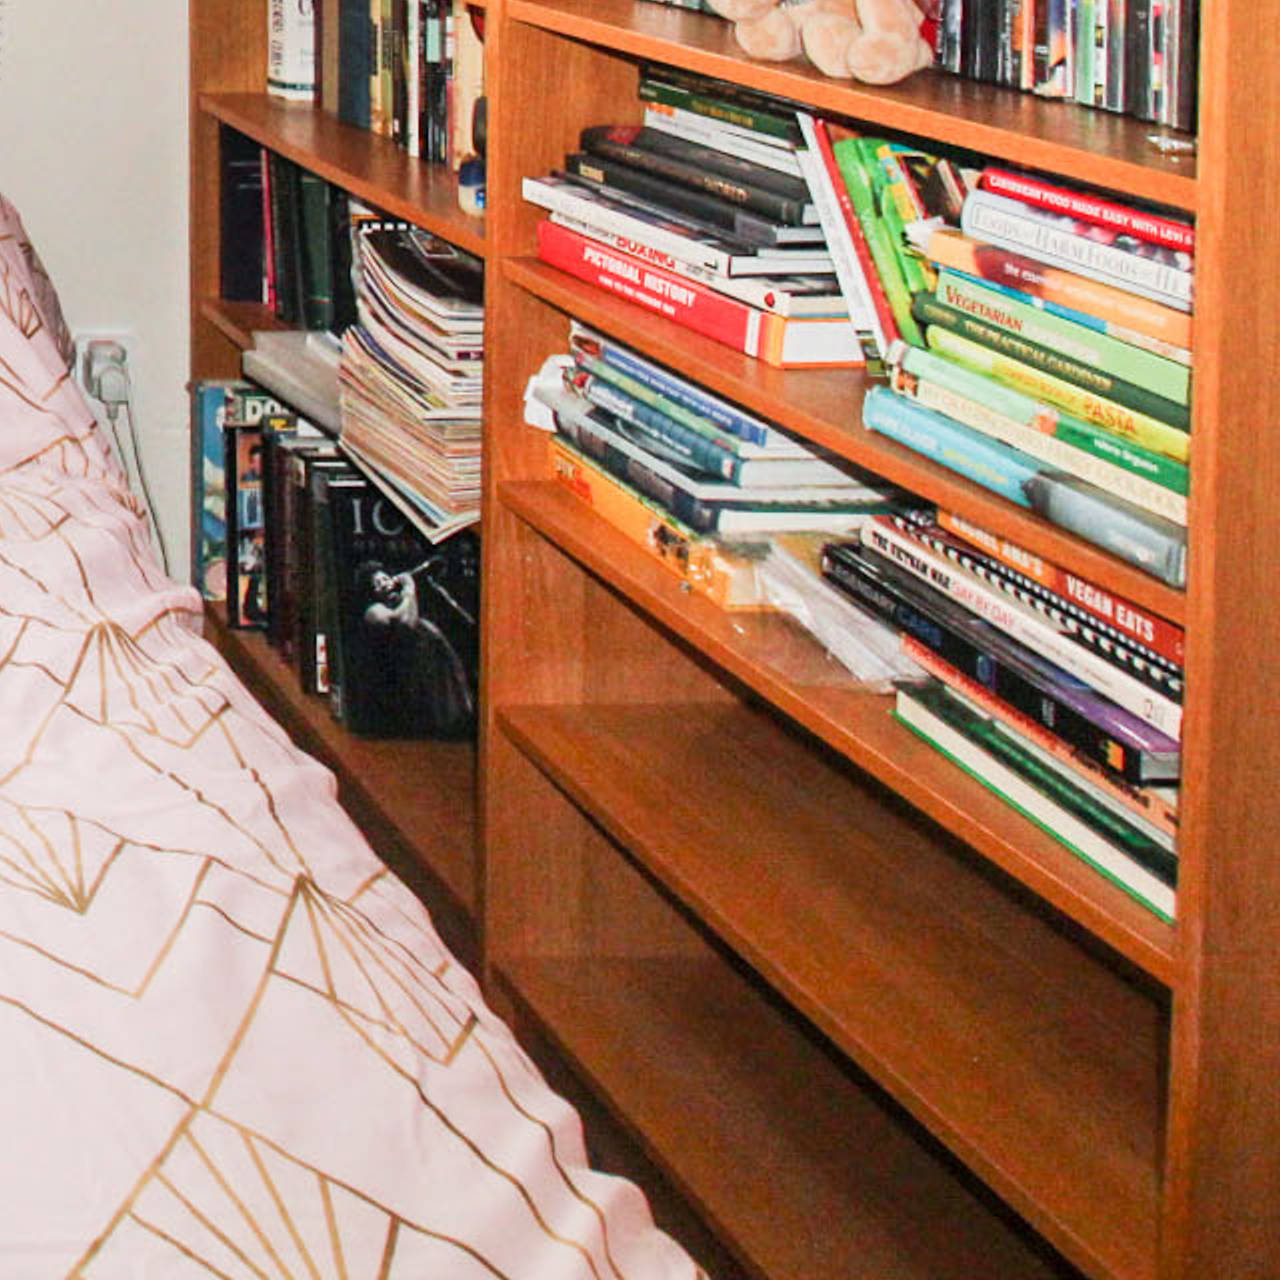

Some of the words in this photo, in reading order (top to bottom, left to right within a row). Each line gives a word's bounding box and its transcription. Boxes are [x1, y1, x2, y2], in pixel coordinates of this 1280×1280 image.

[1042, 192, 1070, 208] FOOD
[1072, 199, 1101, 217] MADE
[1103, 208, 1129, 226] EASY
[1131, 216, 1158, 236] WITH
[583, 245, 641, 284] PICTORIAL
[644, 271, 697, 308] HISTORY
[945, 285, 1024, 332] VEGETARIAN
[1066, 573, 1113, 619] VEGAN
[1116, 601, 1155, 643] EATS
